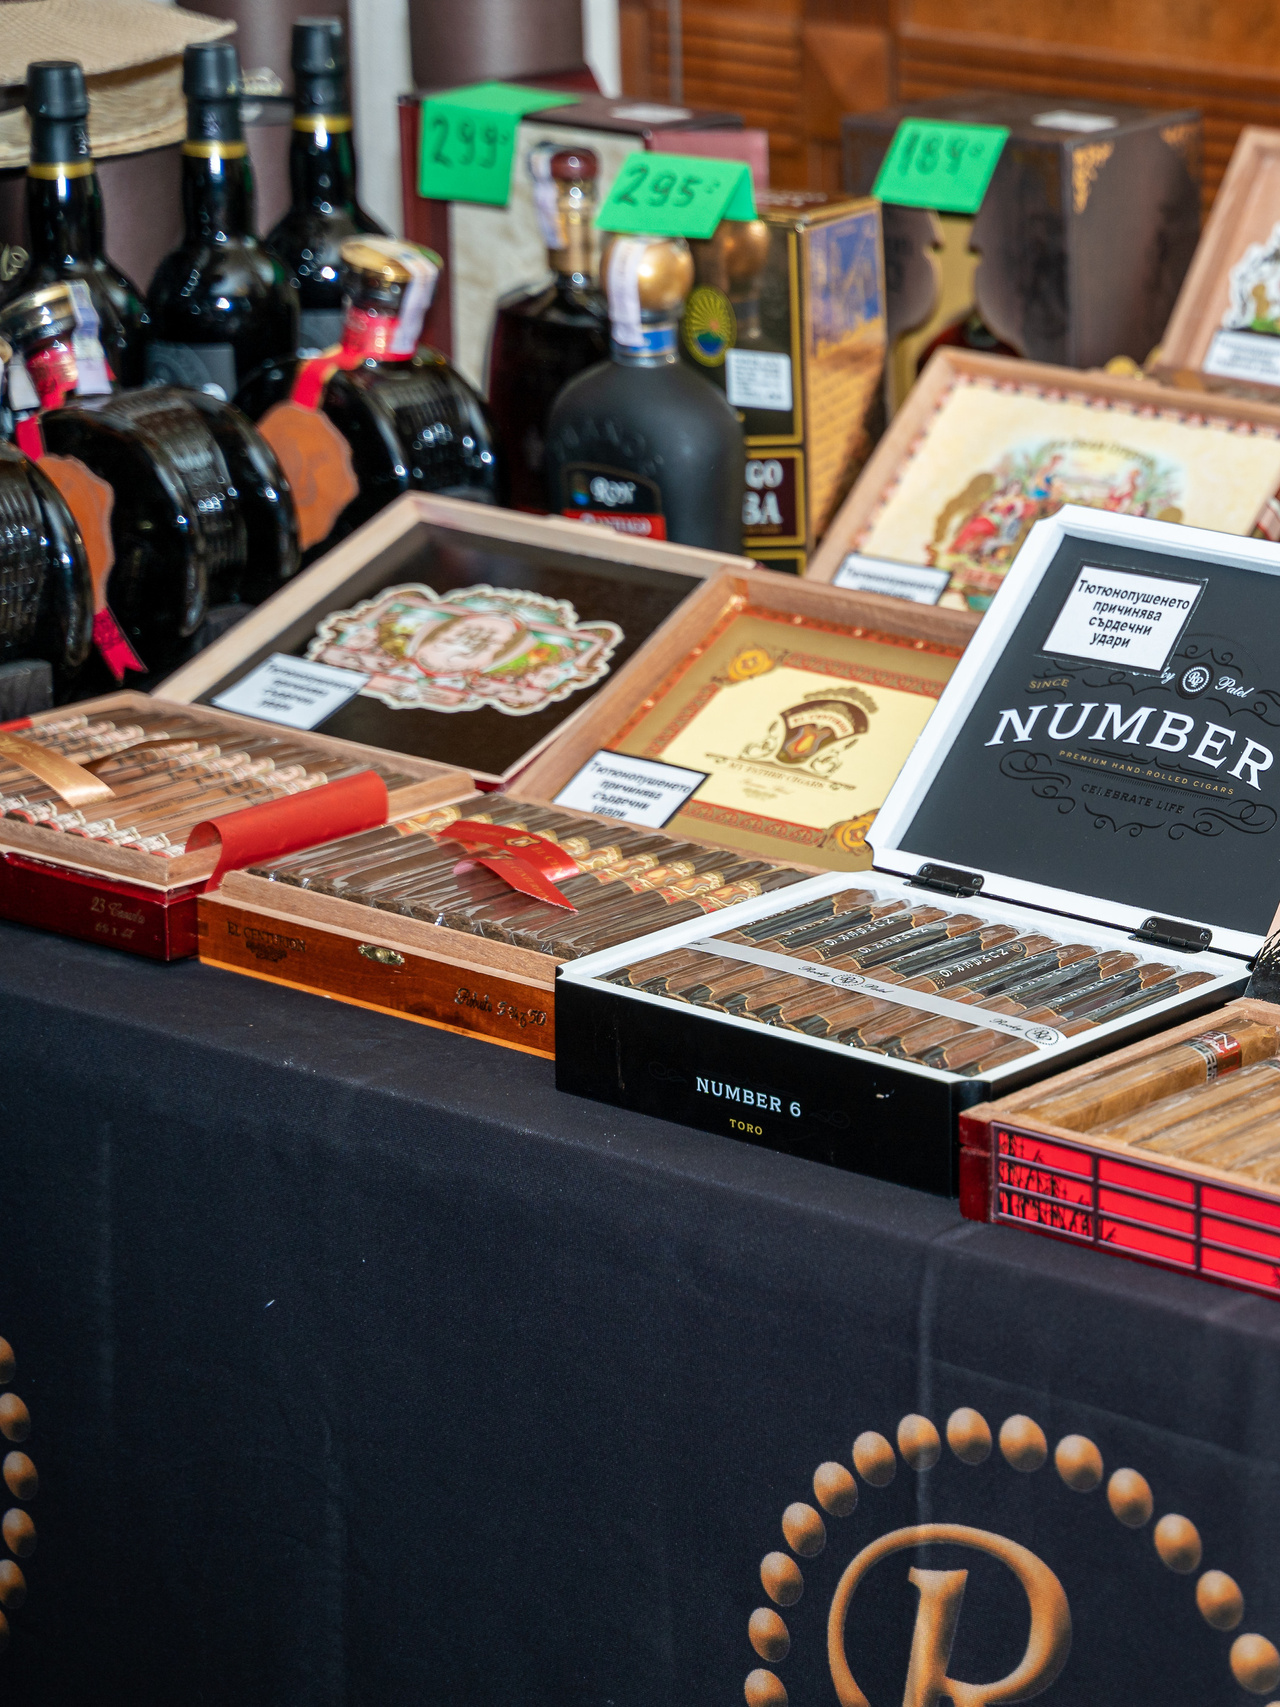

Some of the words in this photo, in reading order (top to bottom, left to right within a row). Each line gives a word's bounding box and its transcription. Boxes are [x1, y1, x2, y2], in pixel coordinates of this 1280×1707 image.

[1077, 579, 1190, 610] Тютюнопушенето
[1093, 601, 1162, 622] причинява
[1088, 616, 1153, 636] сърдечни
[1089, 632, 1131, 649] удари
[1029, 677, 1070, 690] SINCE
[1215, 675, 1255, 698] Patel
[984, 703, 1274, 791] NUMBER
[1059, 750, 1107, 766] PREMIUM
[1111, 762, 1189, 785] HAND-ROLLED
[1193, 780, 1235, 795] CIGARS
[1081, 783, 1153, 806] CELEBRATE
[1156, 800, 1185, 815] LIFE
[696, 1077, 781, 1113] NUMBER
[789, 1102, 802, 1117] 6
[729, 1118, 763, 1136] TORO
